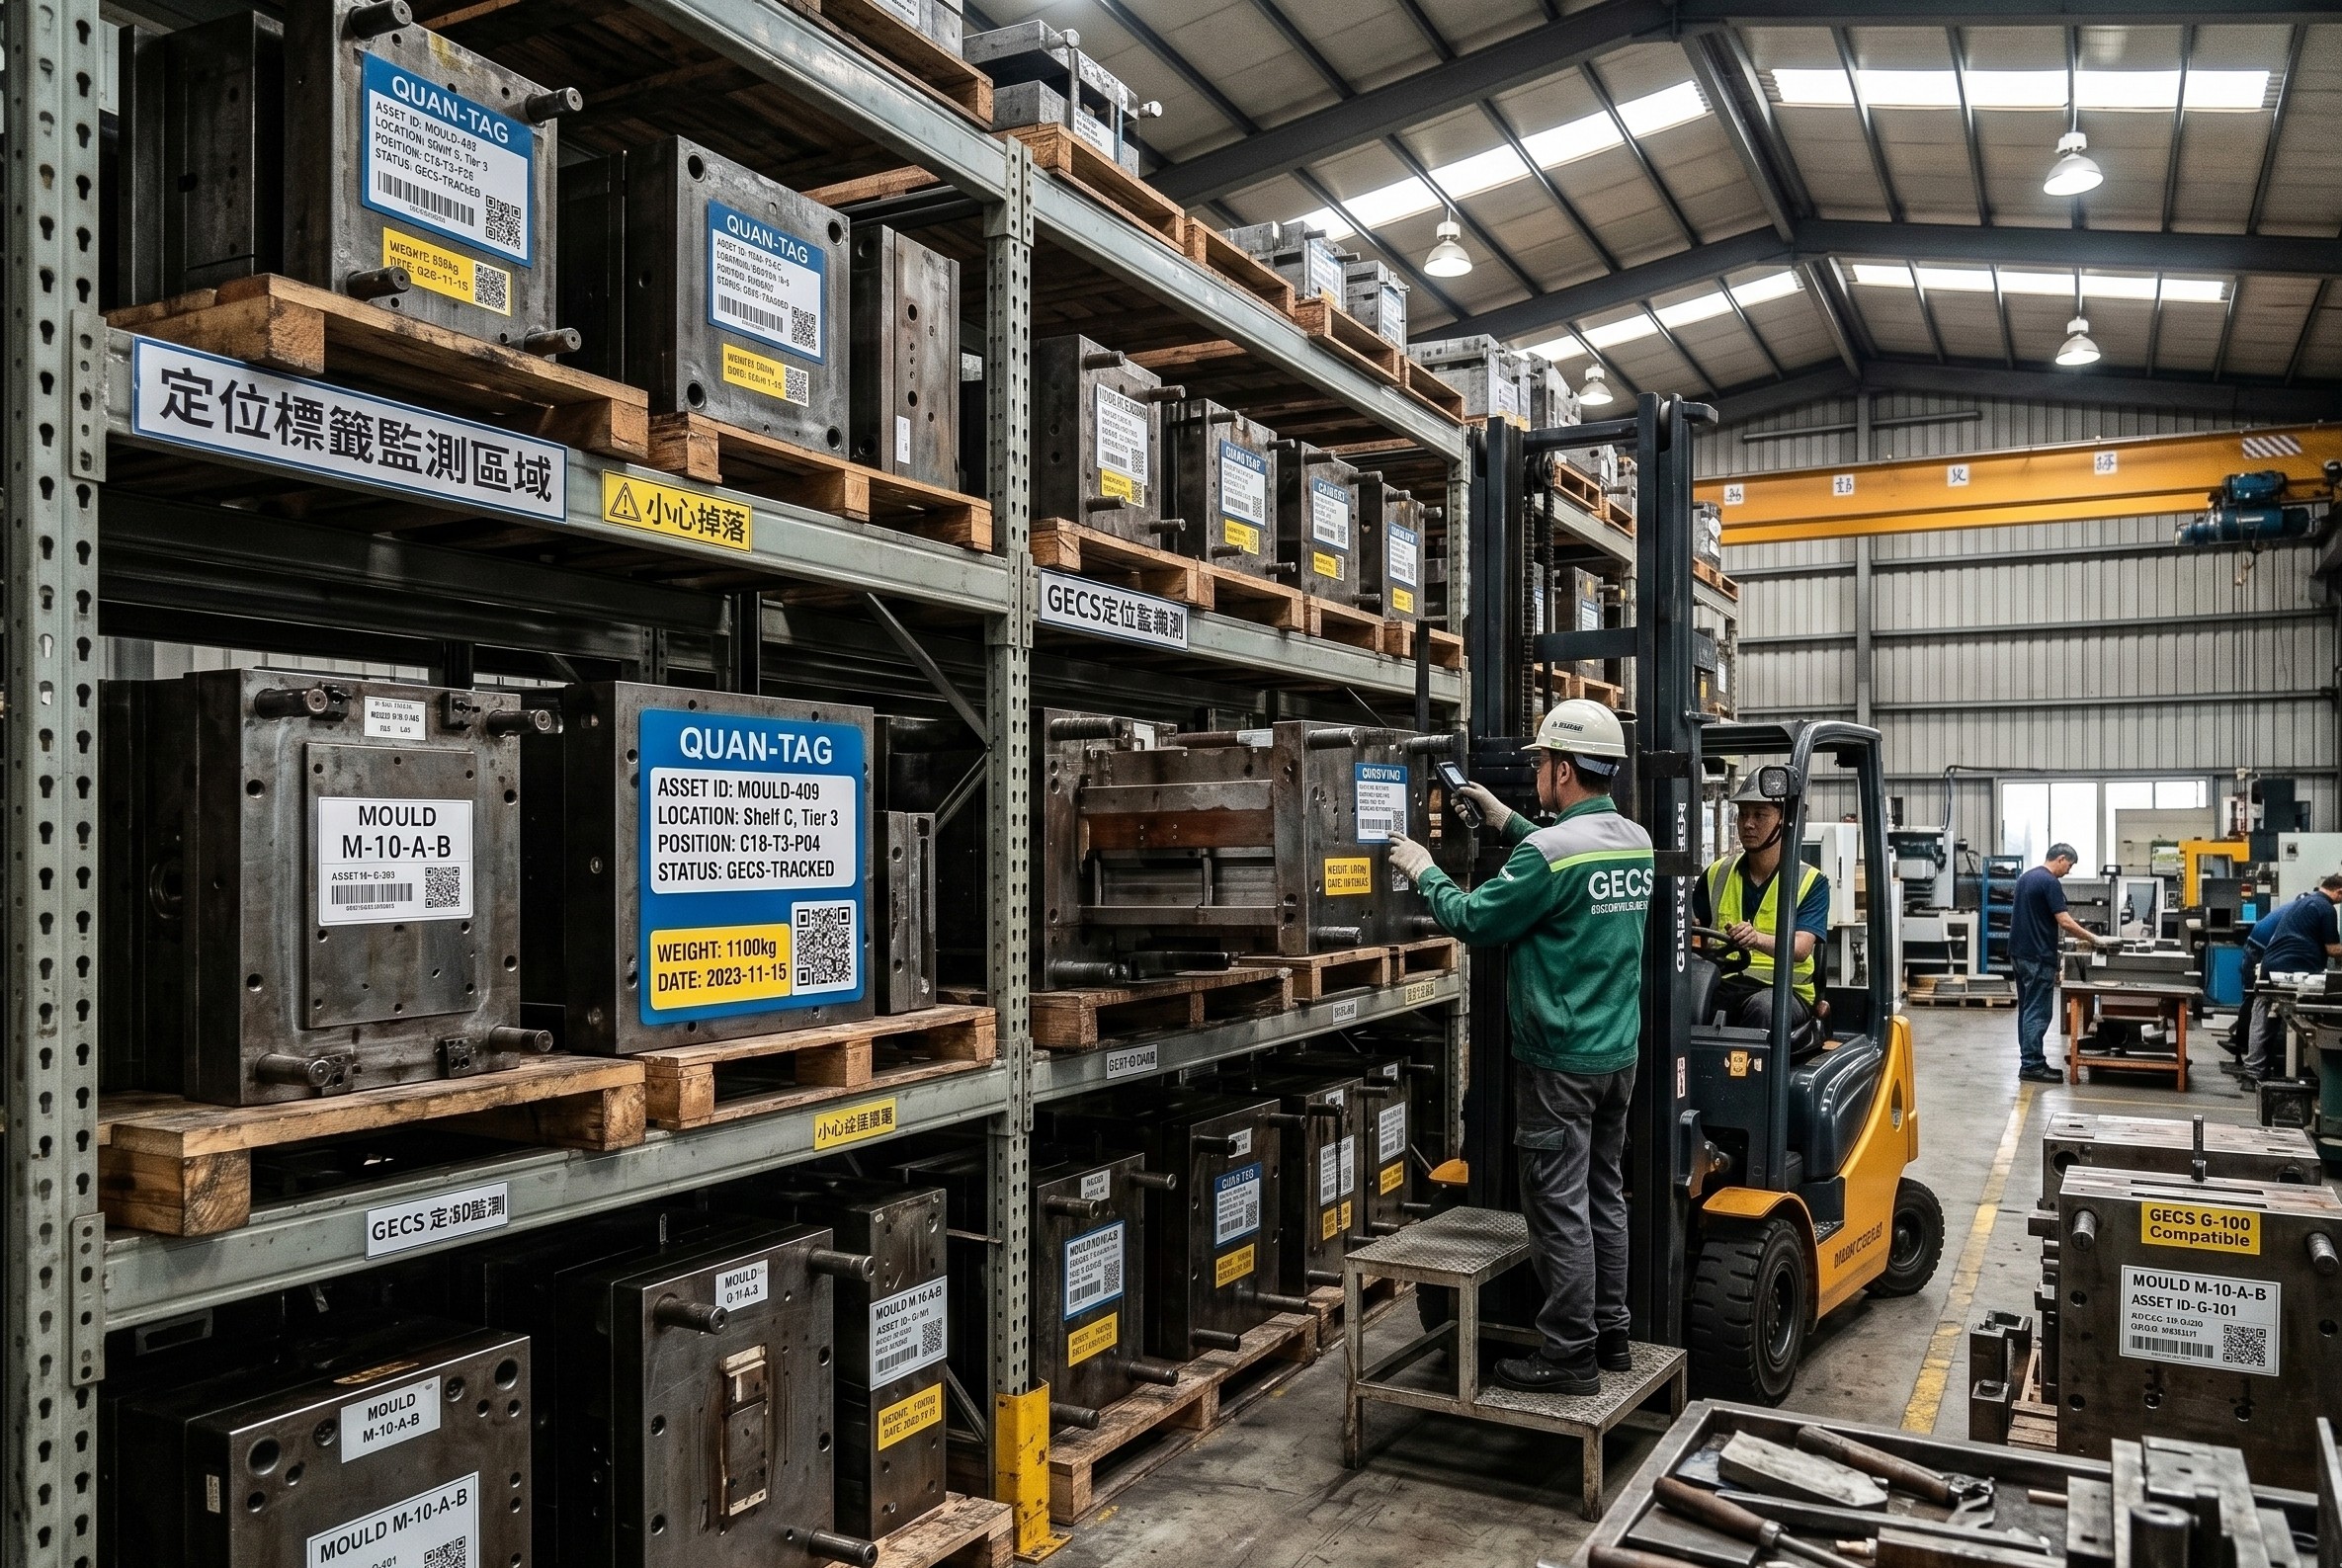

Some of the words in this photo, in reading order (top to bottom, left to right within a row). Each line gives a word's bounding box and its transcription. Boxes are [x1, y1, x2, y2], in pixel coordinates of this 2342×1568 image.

[376, 101, 405, 122] ASSET
[409, 115, 422, 129] ID:
[391, 75, 509, 144] QUAN-TAG
[482, 161, 488, 172] 3
[726, 214, 808, 265] QUAN-TAG
[158, 366, 553, 503] 定位標籤監測區域
[645, 491, 747, 544] 小心掉落
[680, 726, 833, 766] QUAN-TAG
[658, 778, 709, 797] ASSET
[714, 780, 733, 798] ID:
[737, 781, 820, 800] MOULD-409
[359, 805, 437, 827] MOULD
[658, 806, 739, 826] LOCATION:
[743, 808, 781, 827] Shelf
[784, 809, 797, 828] C,
[801, 809, 827, 827] Tier
[830, 809, 839, 827] 3
[342, 835, 452, 859] M-10-A-B
[658, 834, 736, 854] POSITION:
[740, 834, 821, 854] C18-T3-P04
[331, 871, 359, 880] ASSET
[658, 862, 722, 881] STATUS:
[726, 860, 835, 879] GECS-TRACKED
[1588, 868, 1653, 900] GECS
[657, 941, 722, 963] WEIGHT:
[726, 938, 777, 961] 1100kg
[658, 969, 702, 992] DATE:
[707, 962, 788, 987] 2023-11-15
[372, 1212, 425, 1241] GECS
[2149, 1208, 2196, 1225] GECS
[2200, 1213, 2251, 1231] G-100
[2149, 1225, 2250, 1247] Compatible
[724, 1268, 757, 1289] MOULD
[2133, 1274, 2190, 1292] MOULD
[2195, 1281, 2267, 1301] M-10-A-B
[876, 1298, 907, 1321] MOULD
[2132, 1293, 2173, 1309] ASSET
[876, 1319, 899, 1337] ASSET
[368, 1393, 416, 1421] MOULD
[363, 1412, 420, 1444] M-10-A-B
[319, 1521, 387, 1563] MOULD
[393, 1488, 467, 1533] M-10-A-B
